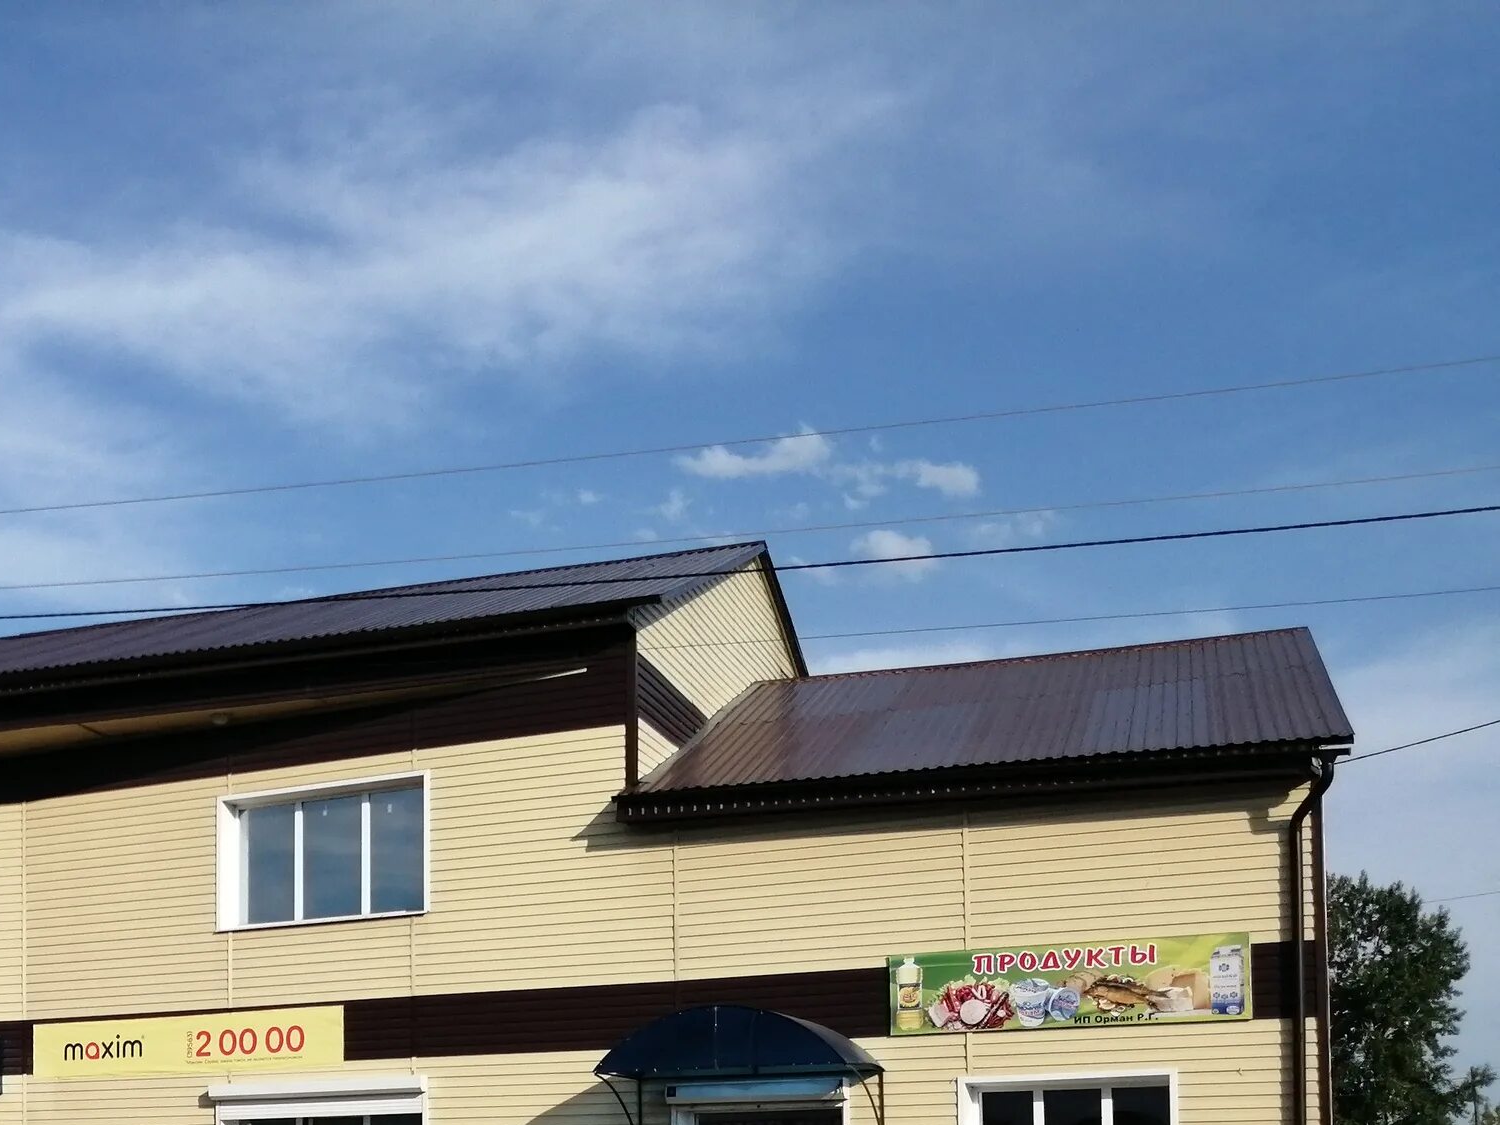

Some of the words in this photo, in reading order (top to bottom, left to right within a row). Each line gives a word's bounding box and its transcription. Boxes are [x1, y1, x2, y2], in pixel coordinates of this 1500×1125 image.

[972, 942, 1157, 975] ПРОДУКТЫ
[1074, 1015, 1091, 1024] ИП
[1095, 1015, 1134, 1026] Орман
[1137, 1013, 1160, 1023] Р.Г.
[64, 1033, 143, 1061] maxim
